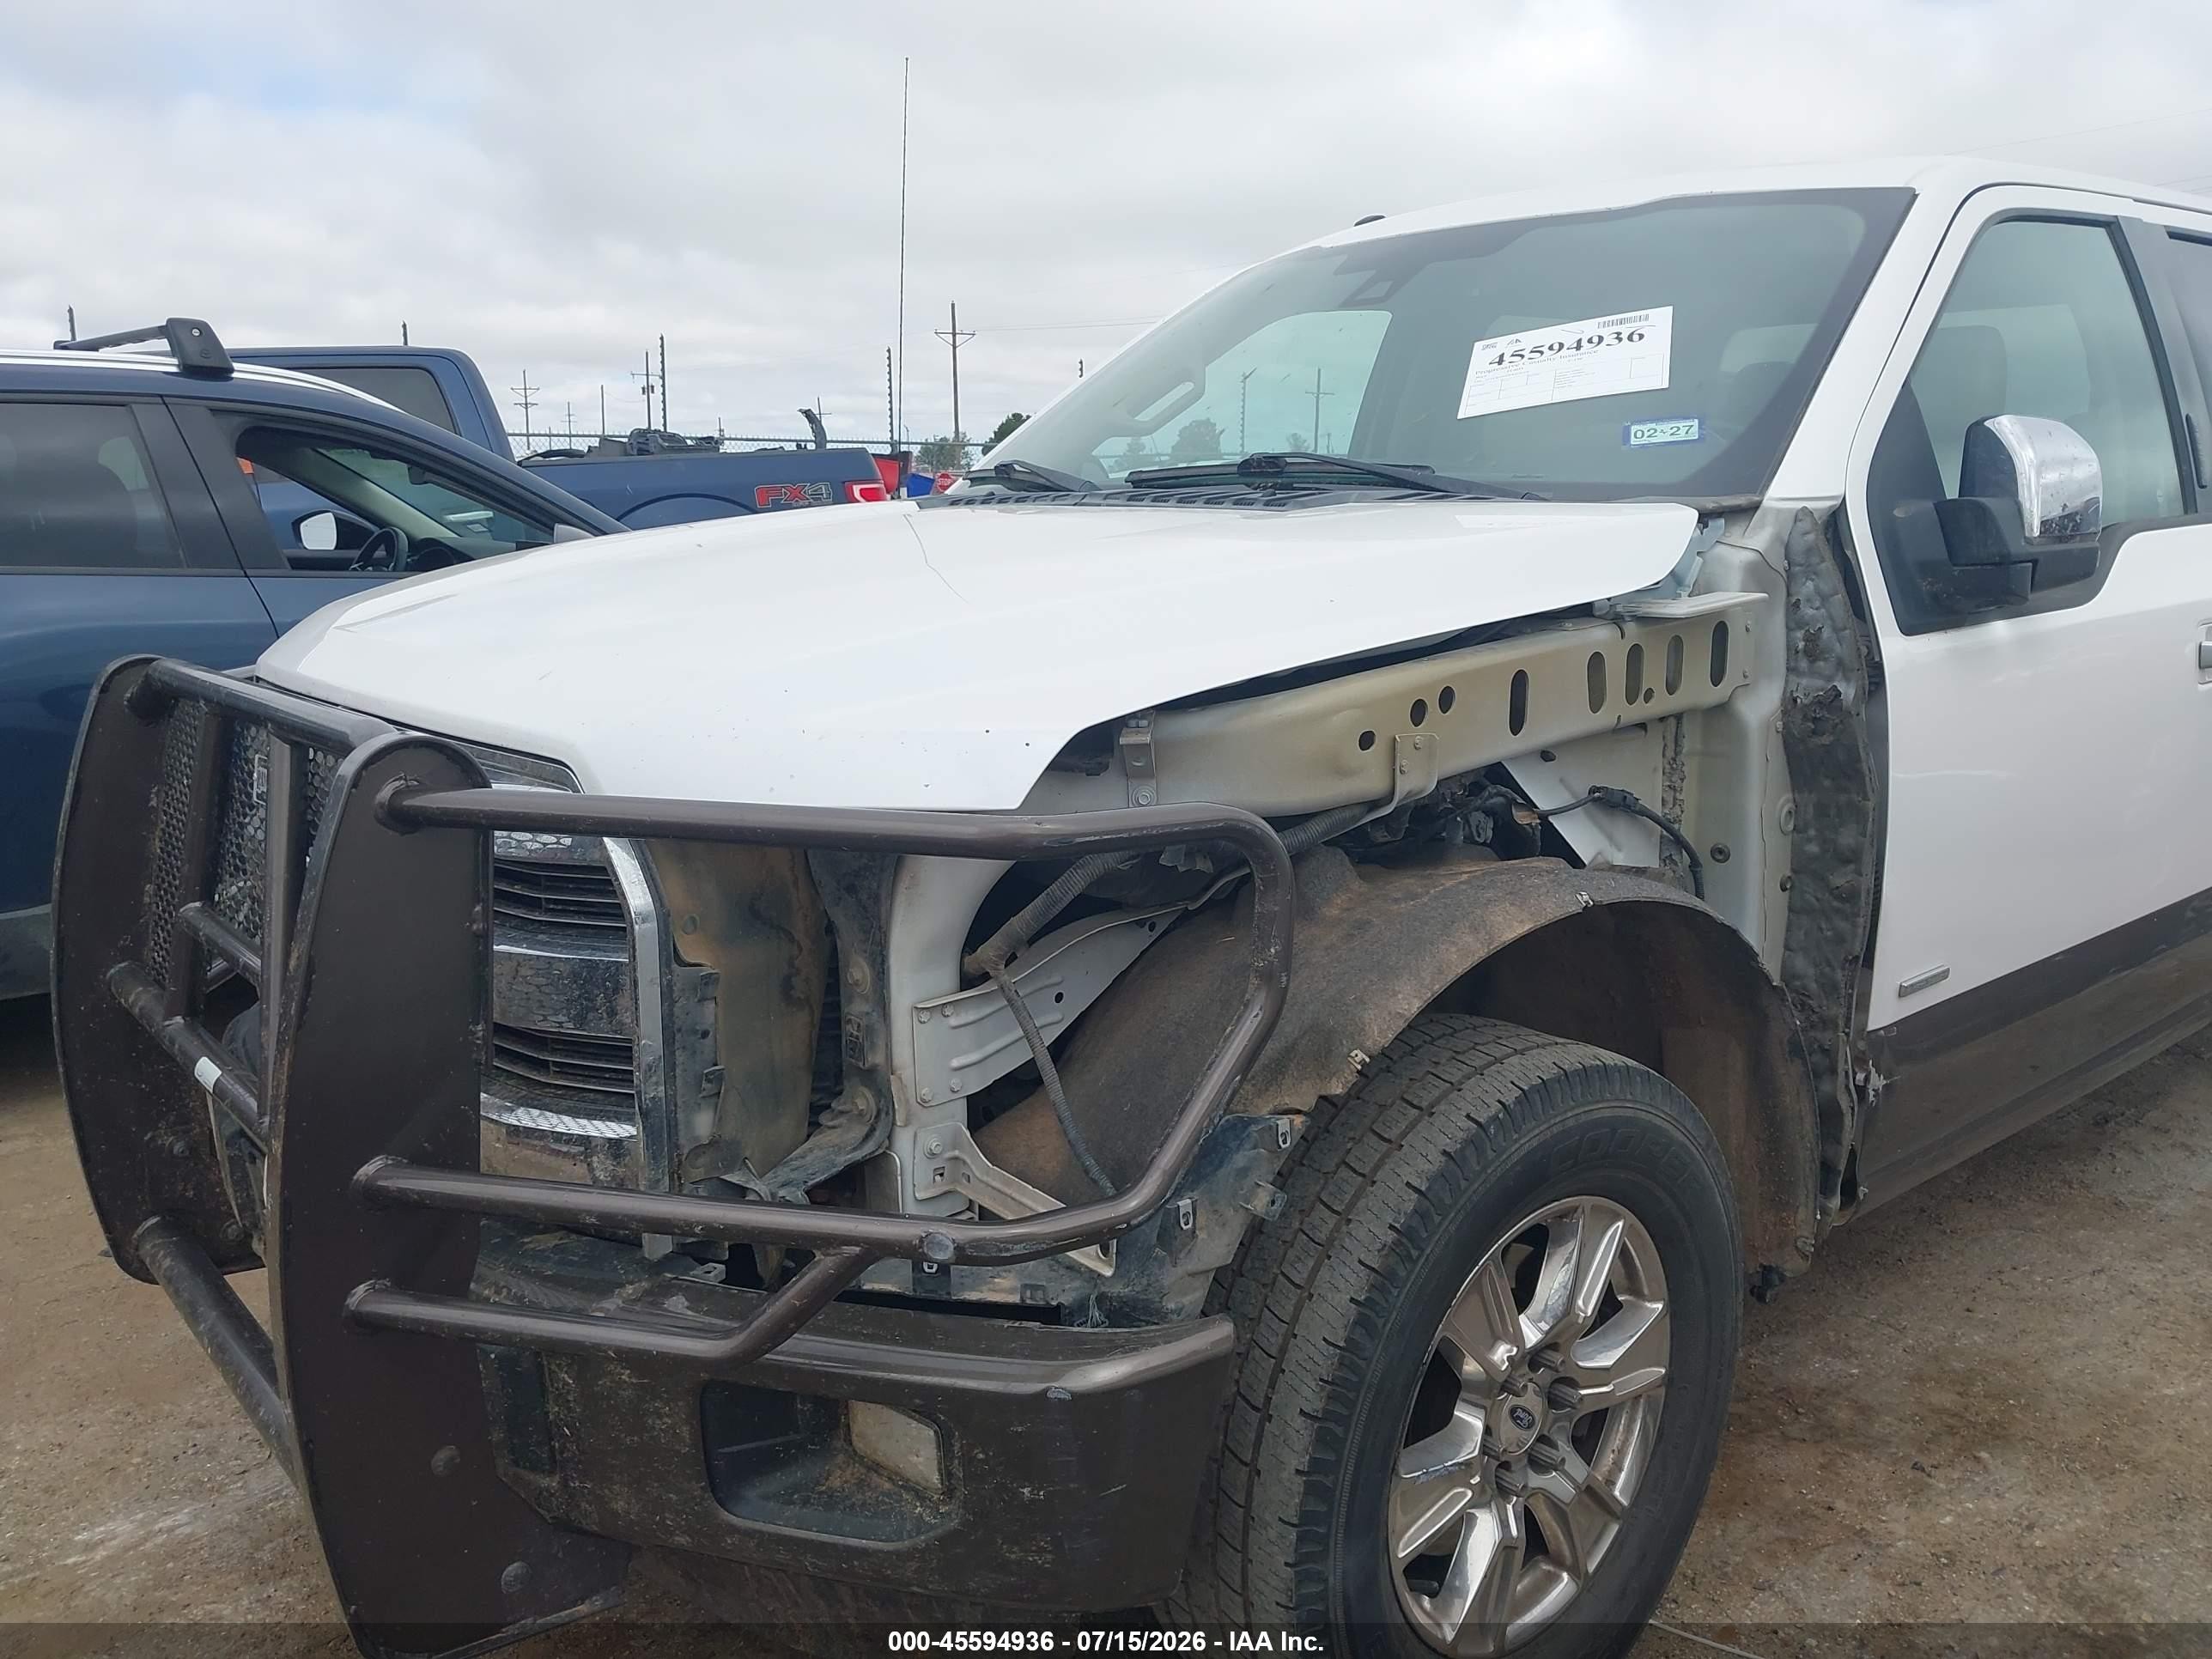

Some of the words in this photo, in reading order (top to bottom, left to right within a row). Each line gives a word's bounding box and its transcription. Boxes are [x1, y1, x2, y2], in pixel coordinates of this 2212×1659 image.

[1488, 328, 1645, 367] 45594936
[938, 477, 953, 486] STOP
[755, 482, 833, 507] FX4
[1552, 1127, 1699, 1188] COOPER
[1513, 1407, 1533, 1428] Ford
